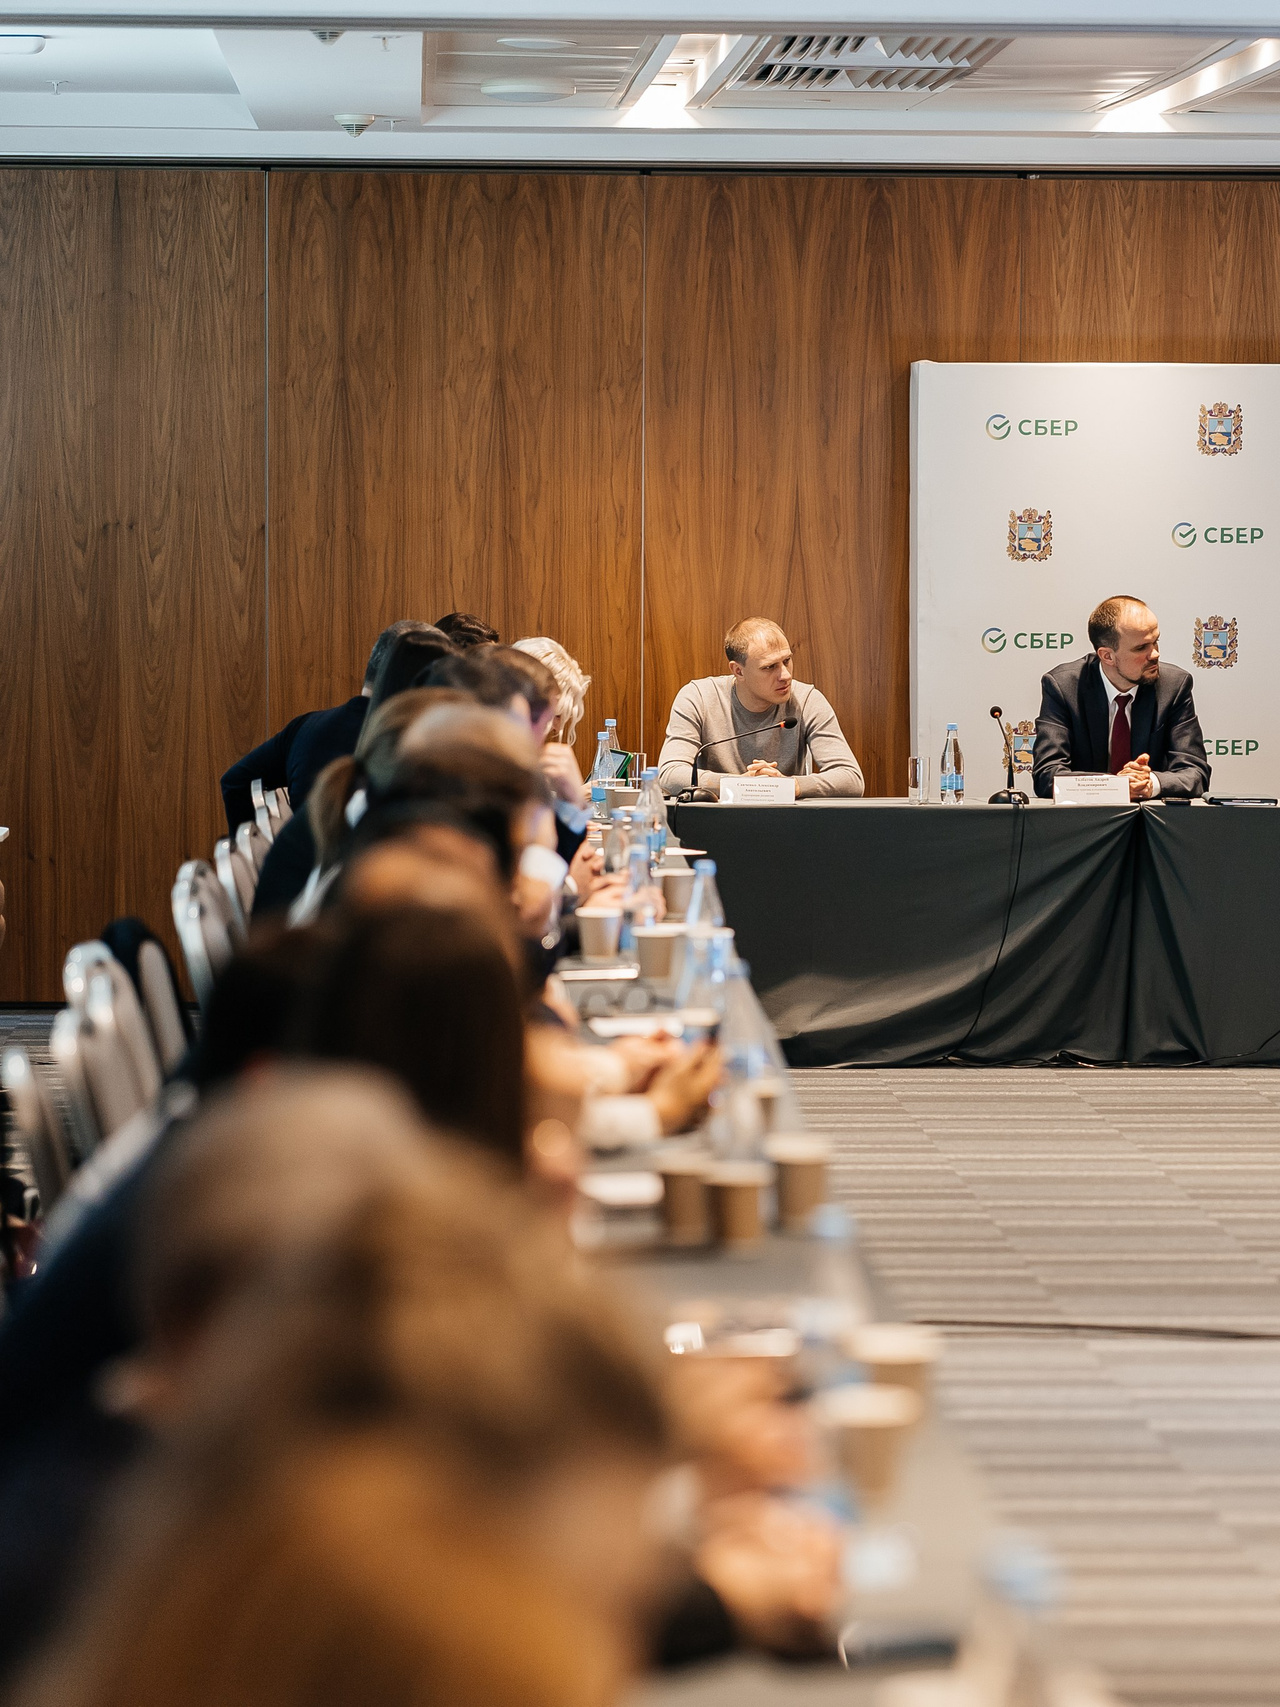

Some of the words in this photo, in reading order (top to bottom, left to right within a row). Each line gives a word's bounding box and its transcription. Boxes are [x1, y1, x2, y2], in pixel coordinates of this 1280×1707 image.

[1017, 419, 1078, 437] СБЕР
[1203, 527, 1264, 544] СБЕР
[1013, 632, 1074, 650] СБЕР
